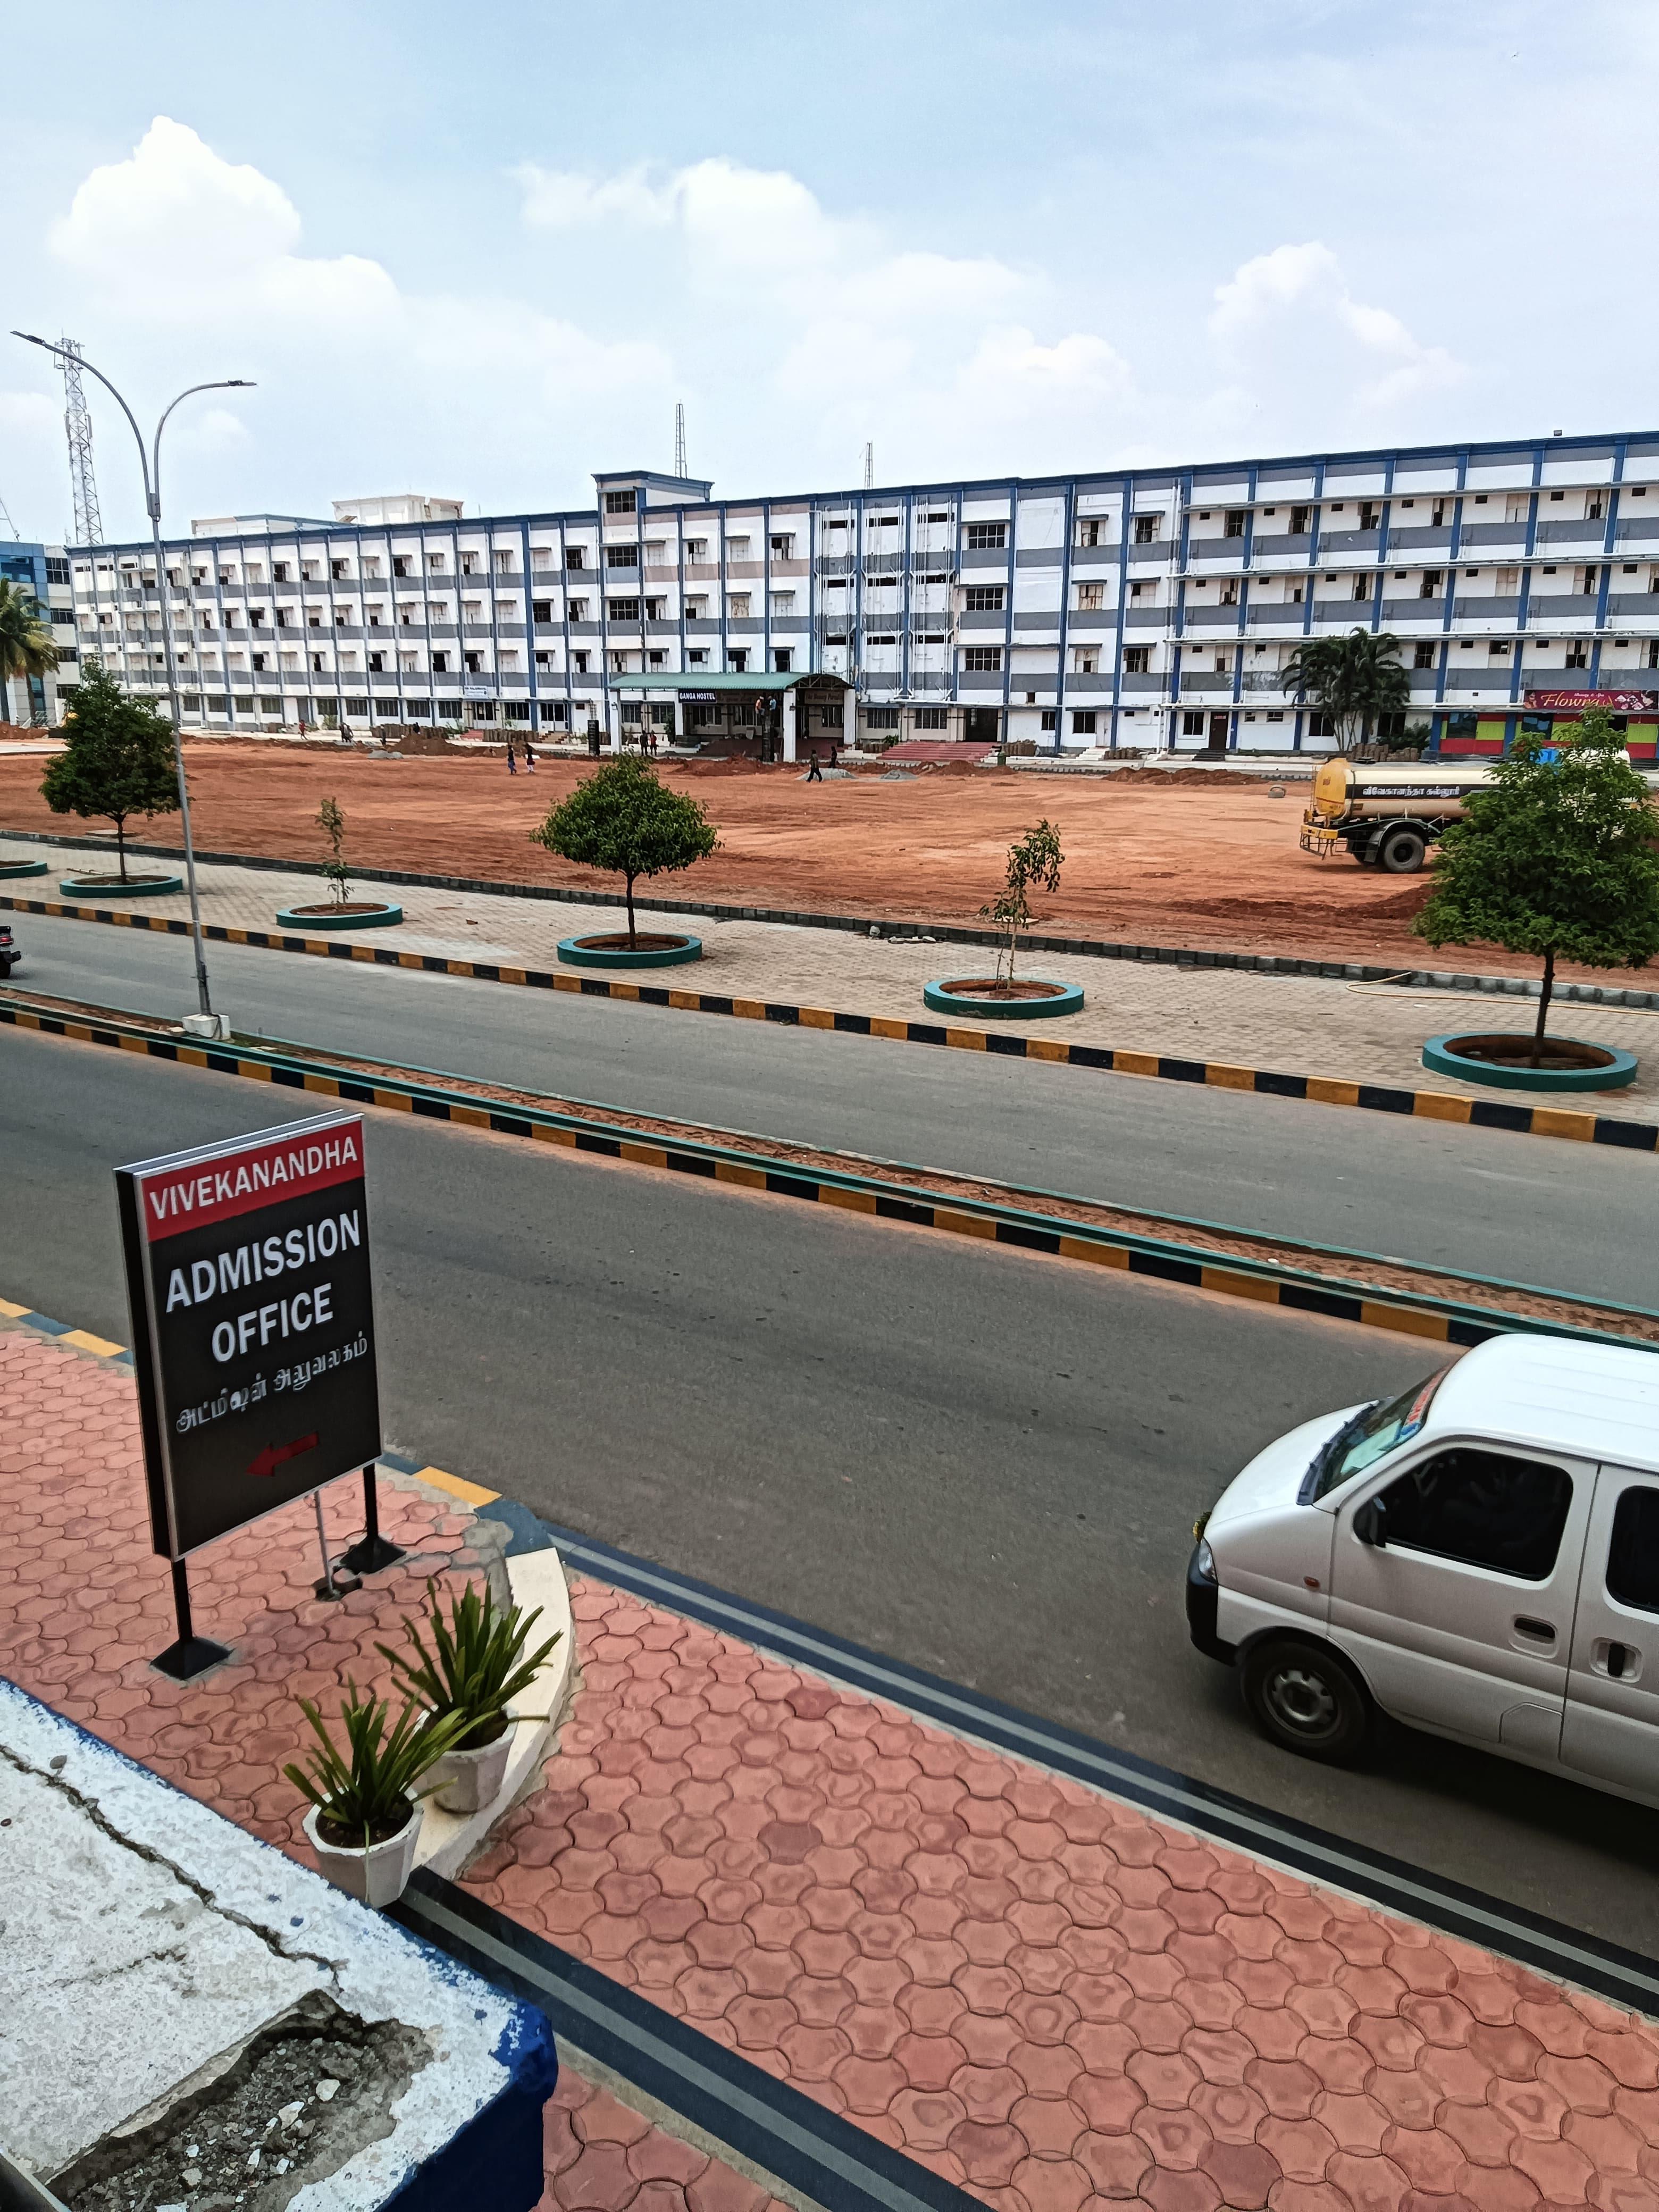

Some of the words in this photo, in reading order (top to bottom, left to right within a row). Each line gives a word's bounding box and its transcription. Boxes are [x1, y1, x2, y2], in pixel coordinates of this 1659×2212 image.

[149, 1136, 358, 1219] VIVEKANANDHA
[166, 1209, 361, 1313] ADMISSION
[212, 1282, 334, 1362] OFFICE
[273, 1330, 368, 1392] அலுவலகம்
